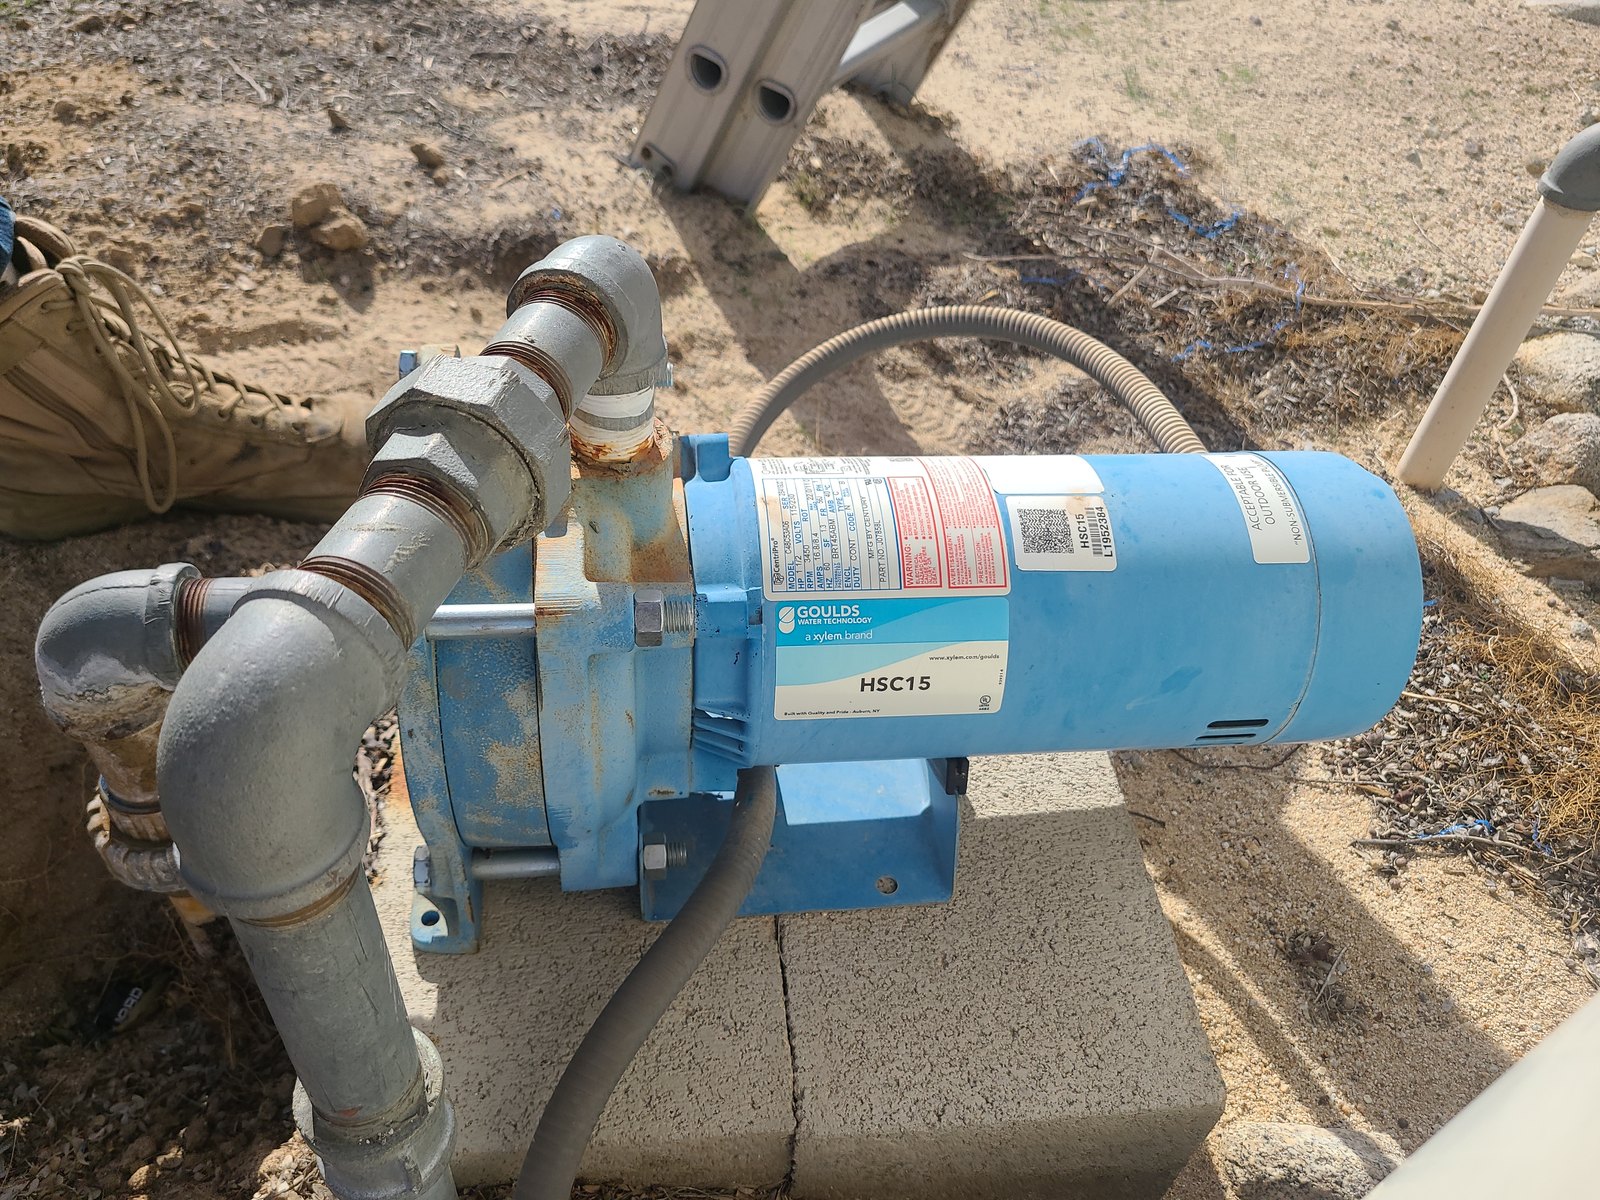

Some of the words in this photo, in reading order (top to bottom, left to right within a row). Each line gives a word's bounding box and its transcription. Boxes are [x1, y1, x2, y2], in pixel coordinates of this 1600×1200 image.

[1220, 464, 1237, 476] FOR
[1236, 467, 1254, 479] USE
[836, 497, 844, 512] TYPE
[1230, 478, 1262, 530] ACCEPTABLE
[1248, 480, 1276, 524] OUTDOOR
[821, 508, 828, 517] FR
[860, 496, 871, 528] CENTURY
[847, 512, 855, 531] CODE
[864, 528, 872, 539] BY
[1075, 514, 1090, 548] HSC15
[1095, 506, 1113, 557] L1952384
[824, 538, 831, 548] SF
[849, 538, 858, 560] CONT
[866, 541, 875, 558] MFG
[803, 545, 811, 562] 3450
[877, 562, 886, 582] PART
[904, 544, 913, 585] WARNING:
[798, 578, 804, 589] HP
[826, 578, 832, 588] HZ
[797, 605, 860, 618] GOULDS
[813, 631, 842, 642] xylem
[845, 629, 872, 639] brand
[860, 676, 930, 692] HSC15
